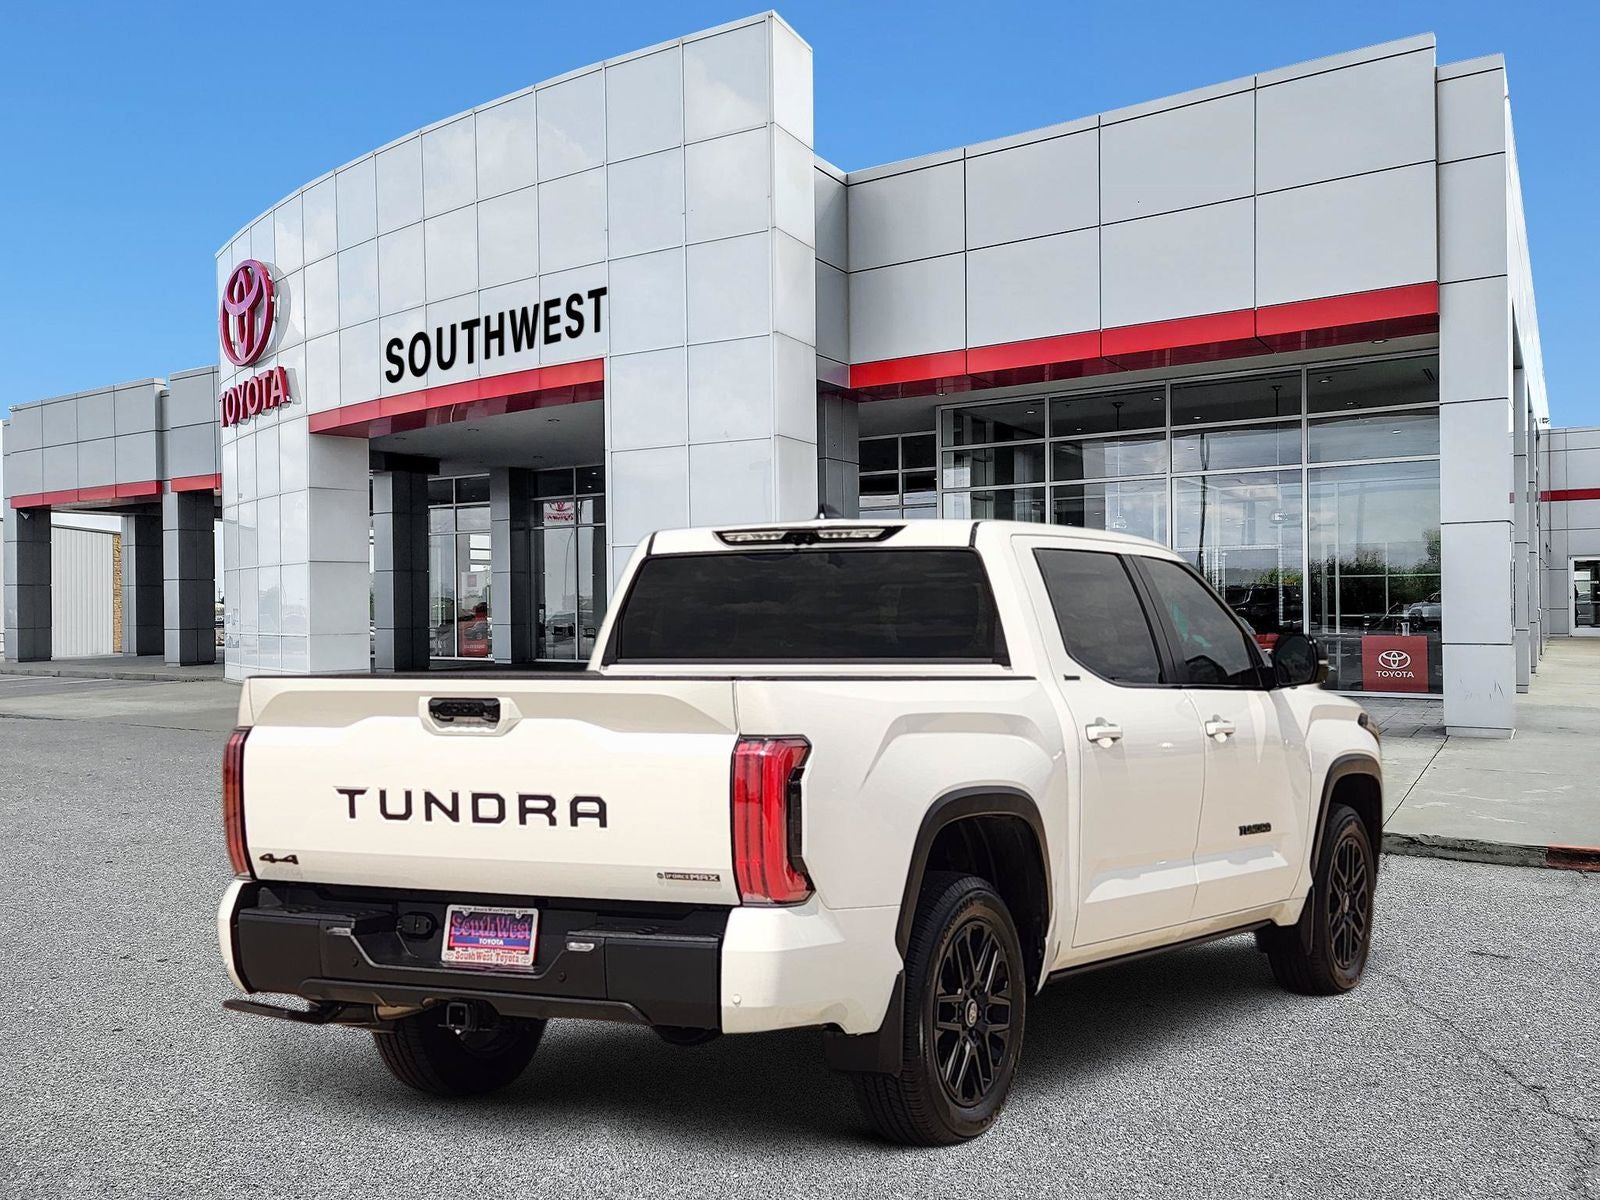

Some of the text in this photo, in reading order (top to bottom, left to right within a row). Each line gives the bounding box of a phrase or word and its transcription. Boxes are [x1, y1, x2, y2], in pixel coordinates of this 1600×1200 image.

[385, 286, 608, 383] SOUTHWEST
[219, 366, 288, 428] TOYOTA
[1376, 670, 1415, 678] TOYOTA
[333, 786, 608, 828] TUNDRA
[479, 938, 504, 946] TOYOTA
[495, 953, 520, 966] Toyota
